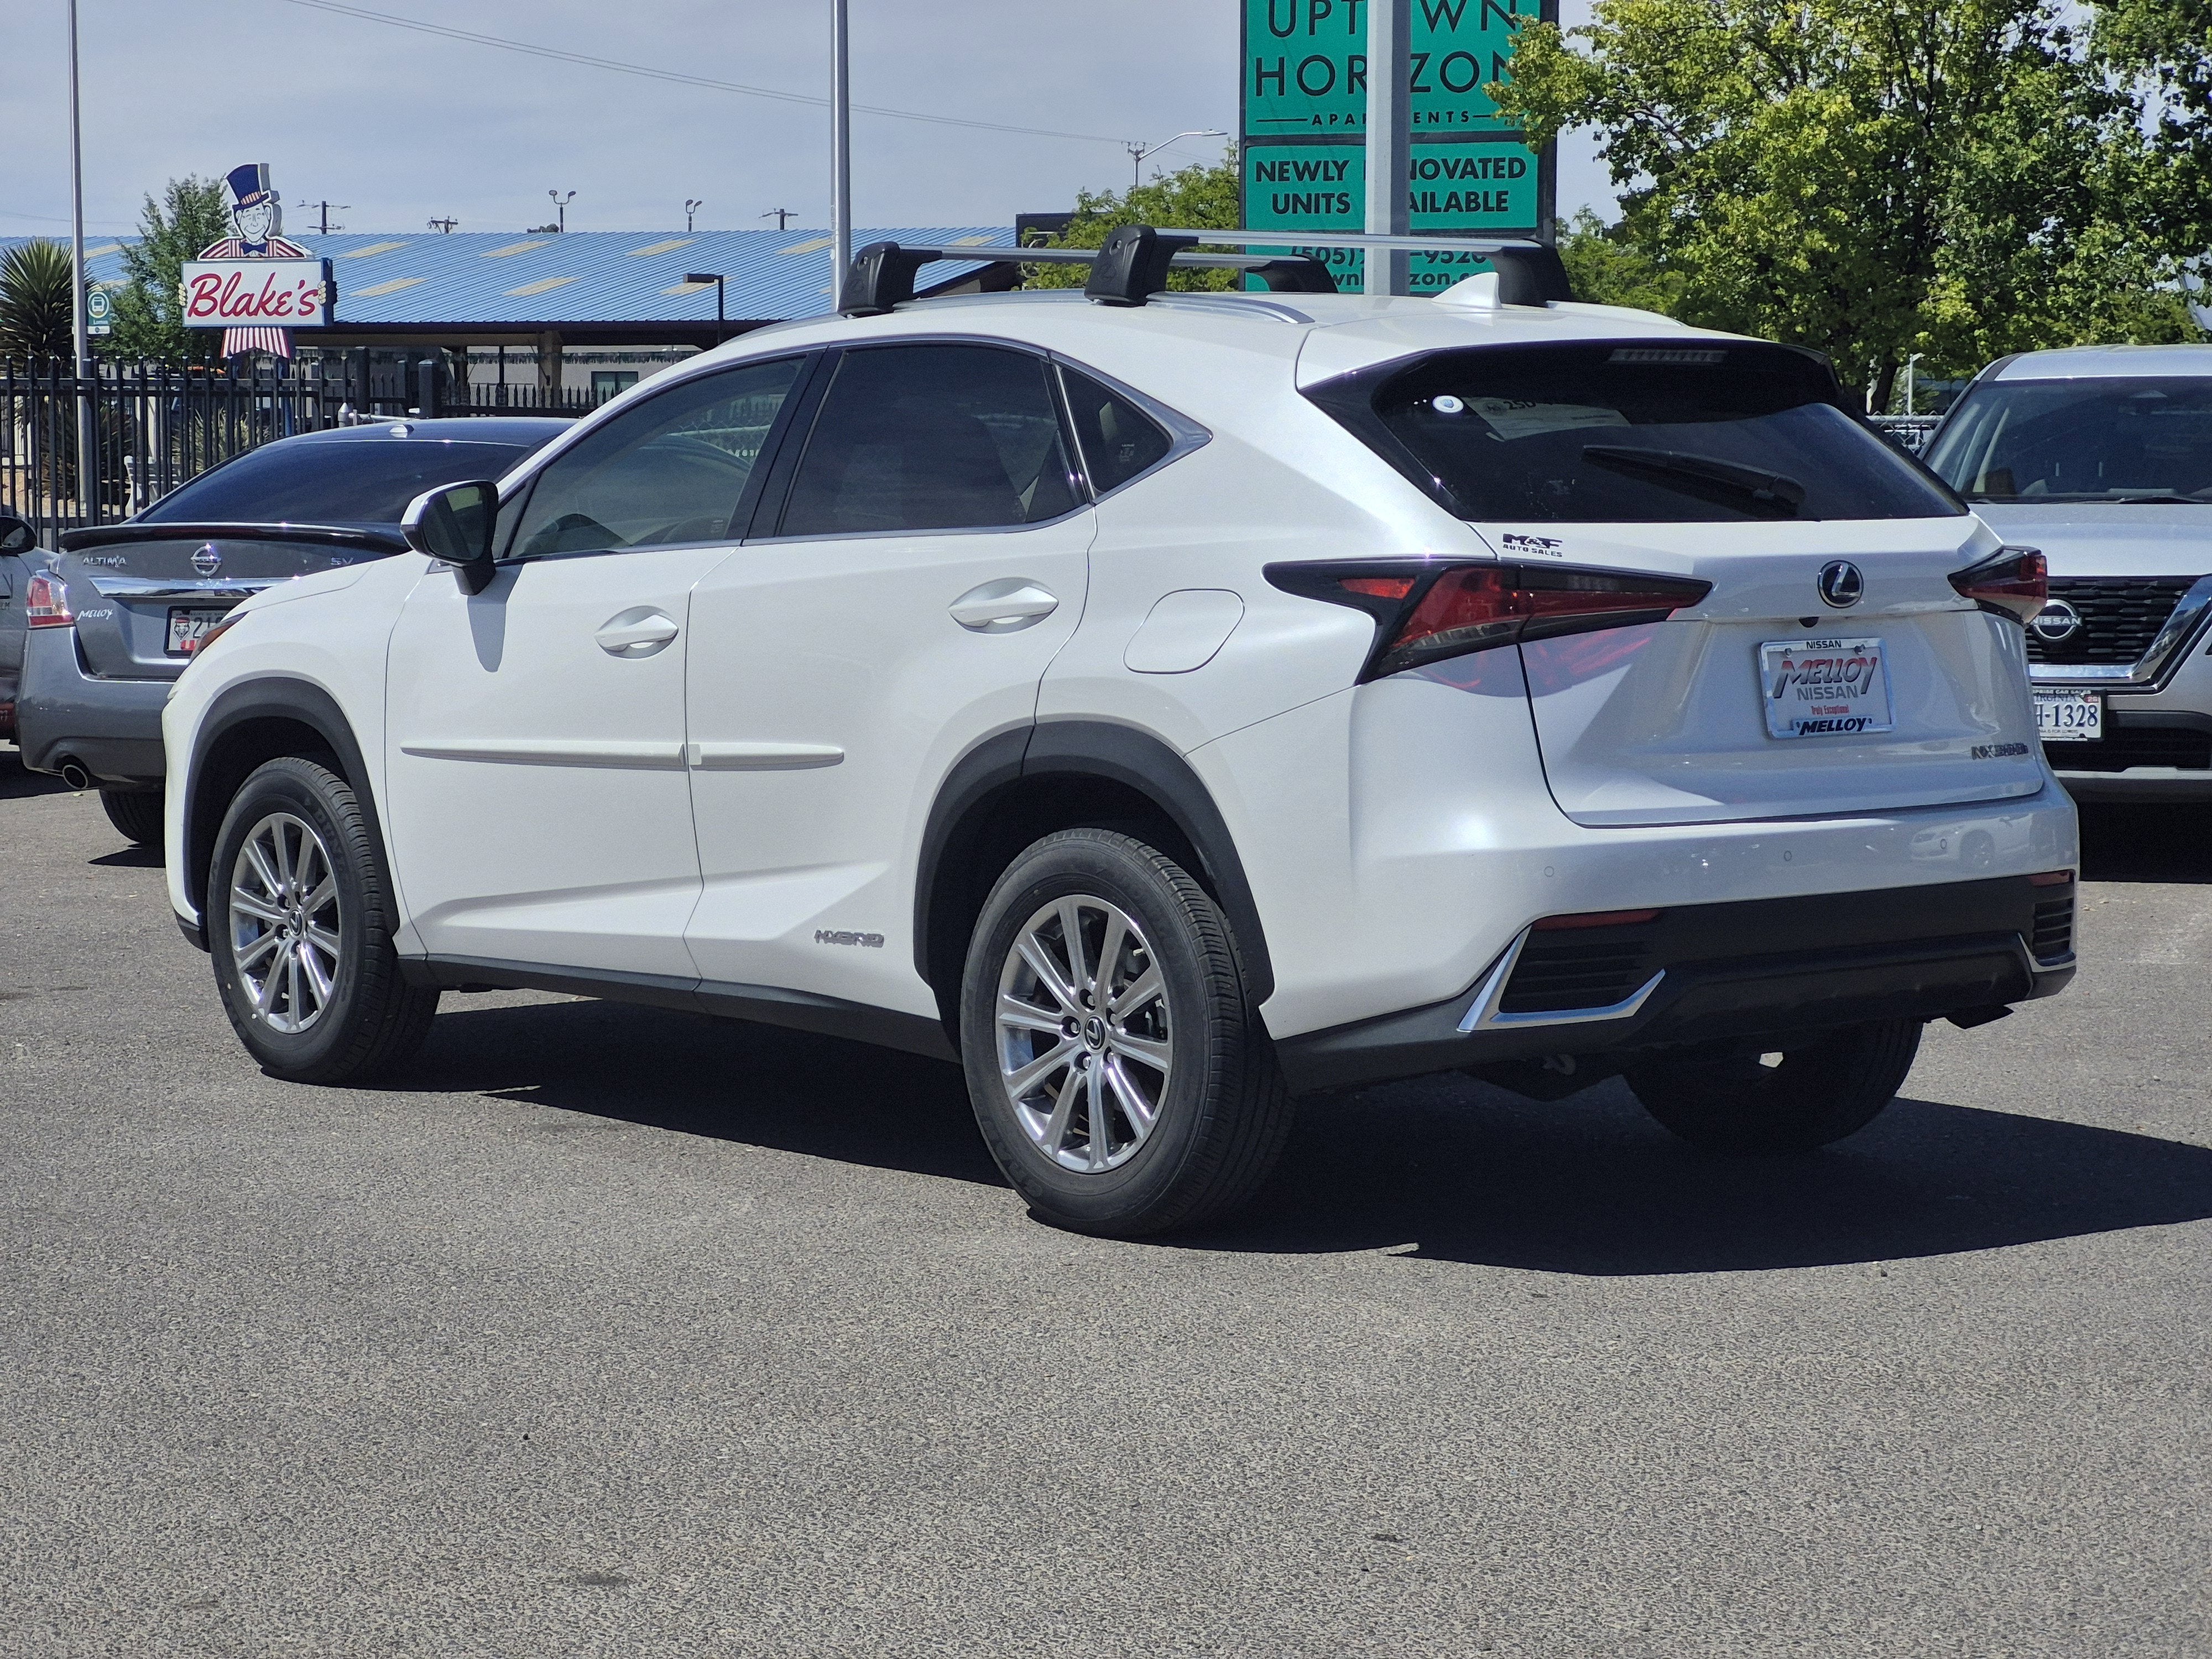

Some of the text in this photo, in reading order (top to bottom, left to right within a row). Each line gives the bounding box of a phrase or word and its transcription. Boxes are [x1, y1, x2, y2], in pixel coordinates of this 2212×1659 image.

[1269, 0, 1516, 37] UPTWN
[1256, 50, 1506, 96] HORZO
[1311, 111, 1470, 126] APAENTS
[1256, 157, 1526, 181] NEWLY OVATED
[1272, 190, 1509, 214] UNITS AILABLE
[187, 272, 319, 317] Blake's
[84, 556, 127, 566] ALTIMA
[1531, 548, 1562, 557] SALES
[1806, 640, 1841, 649] NISSAN
[1797, 685, 1859, 701] NISSAN
[814, 930, 884, 948] HYBRID
